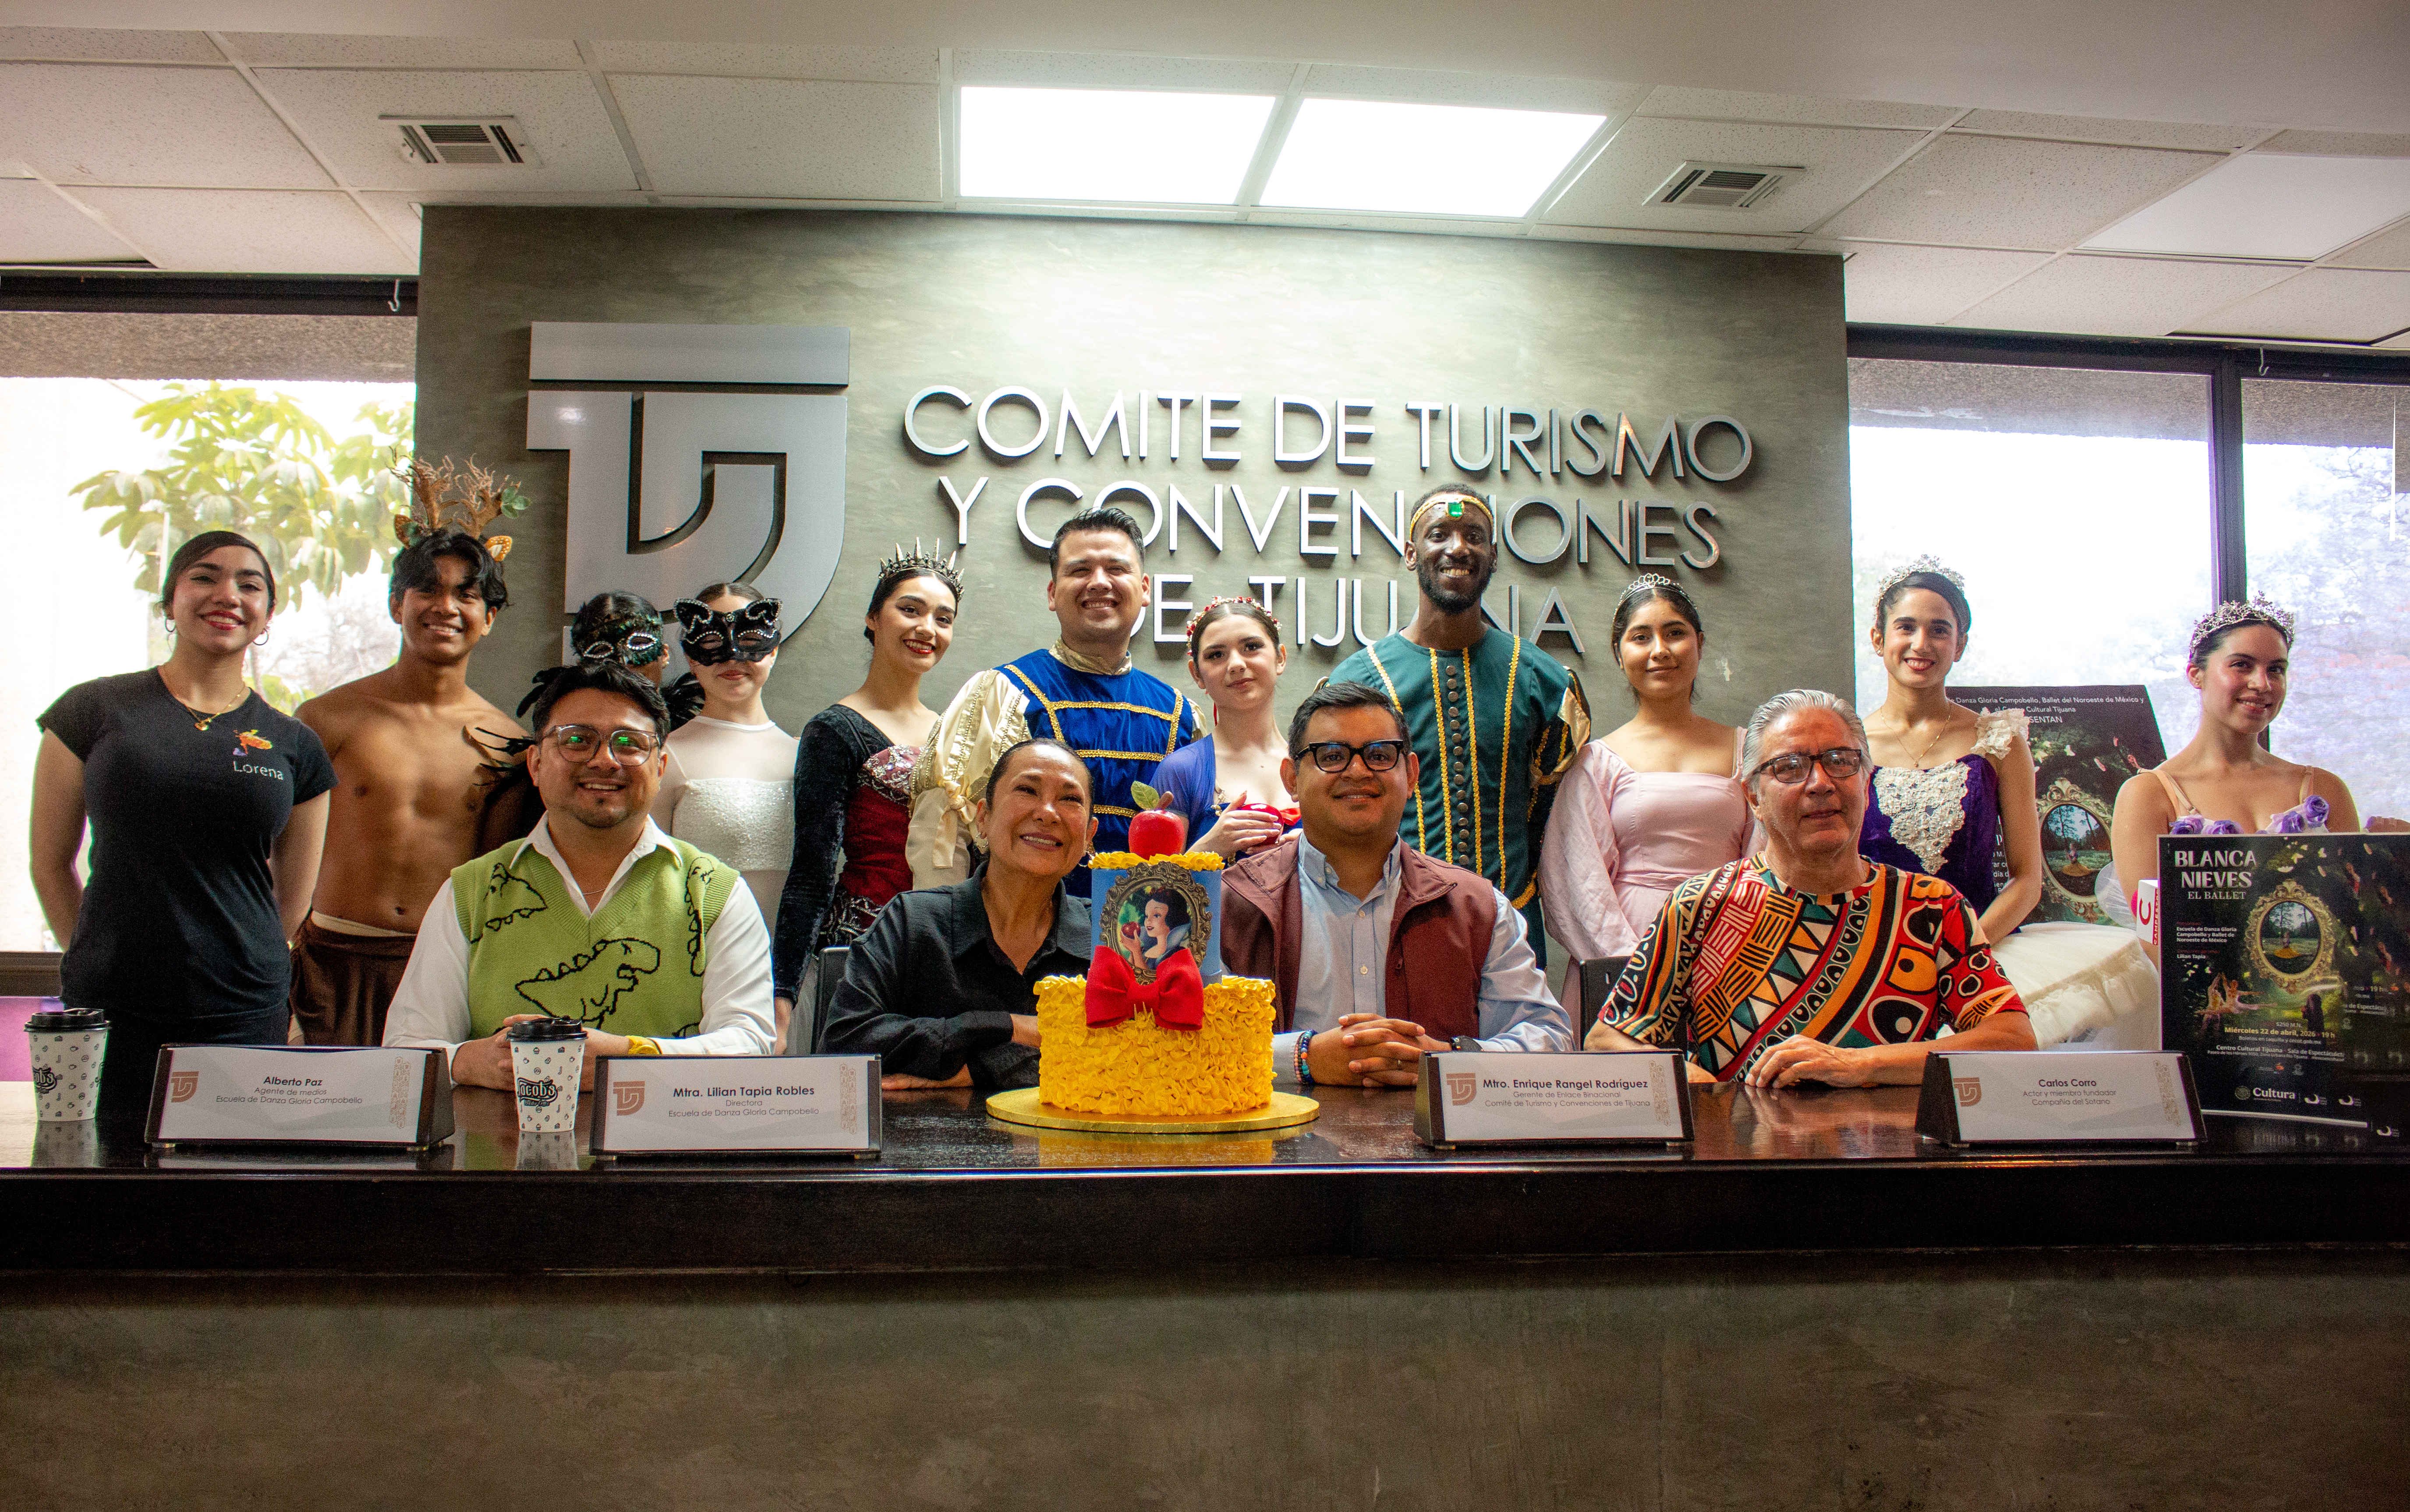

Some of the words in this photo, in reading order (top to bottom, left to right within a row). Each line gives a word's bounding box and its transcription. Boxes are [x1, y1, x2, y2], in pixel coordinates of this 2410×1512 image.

[904, 385, 1241, 463] COMITE
[1274, 395, 1376, 466] DE
[1406, 402, 1752, 483] TURISMO
[939, 476, 988, 545] Y
[1016, 478, 1719, 569] CONVENIONES
[1249, 576, 1585, 654] TIJUNA
[1999, 697, 2040, 705] Campobello,
[233, 761, 284, 780] Lorena
[2174, 851, 2258, 868] BLANCA
[2181, 871, 2252, 888] NIEVES
[2188, 891, 2201, 899] EL
[2204, 891, 2247, 900] BALLET
[263, 1076, 302, 1086] Alberto
[1483, 1079, 1510, 1088] Mtro.
[1513, 1079, 1552, 1090] Enrique
[1556, 1080, 1593, 1090] Rangel
[1596, 1079, 1648, 1090] Rodríguez
[254, 1087, 284, 1095] Agente
[673, 1088, 703, 1097] Mtra.
[708, 1087, 736, 1096] Lilian
[740, 1086, 772, 1098] Tapia
[776, 1086, 814, 1095] Robles
[2253, 1088, 2297, 1099] Cultura
[313, 1097, 362, 1105] Campobello
[769, 1108, 819, 1116] Campobello
